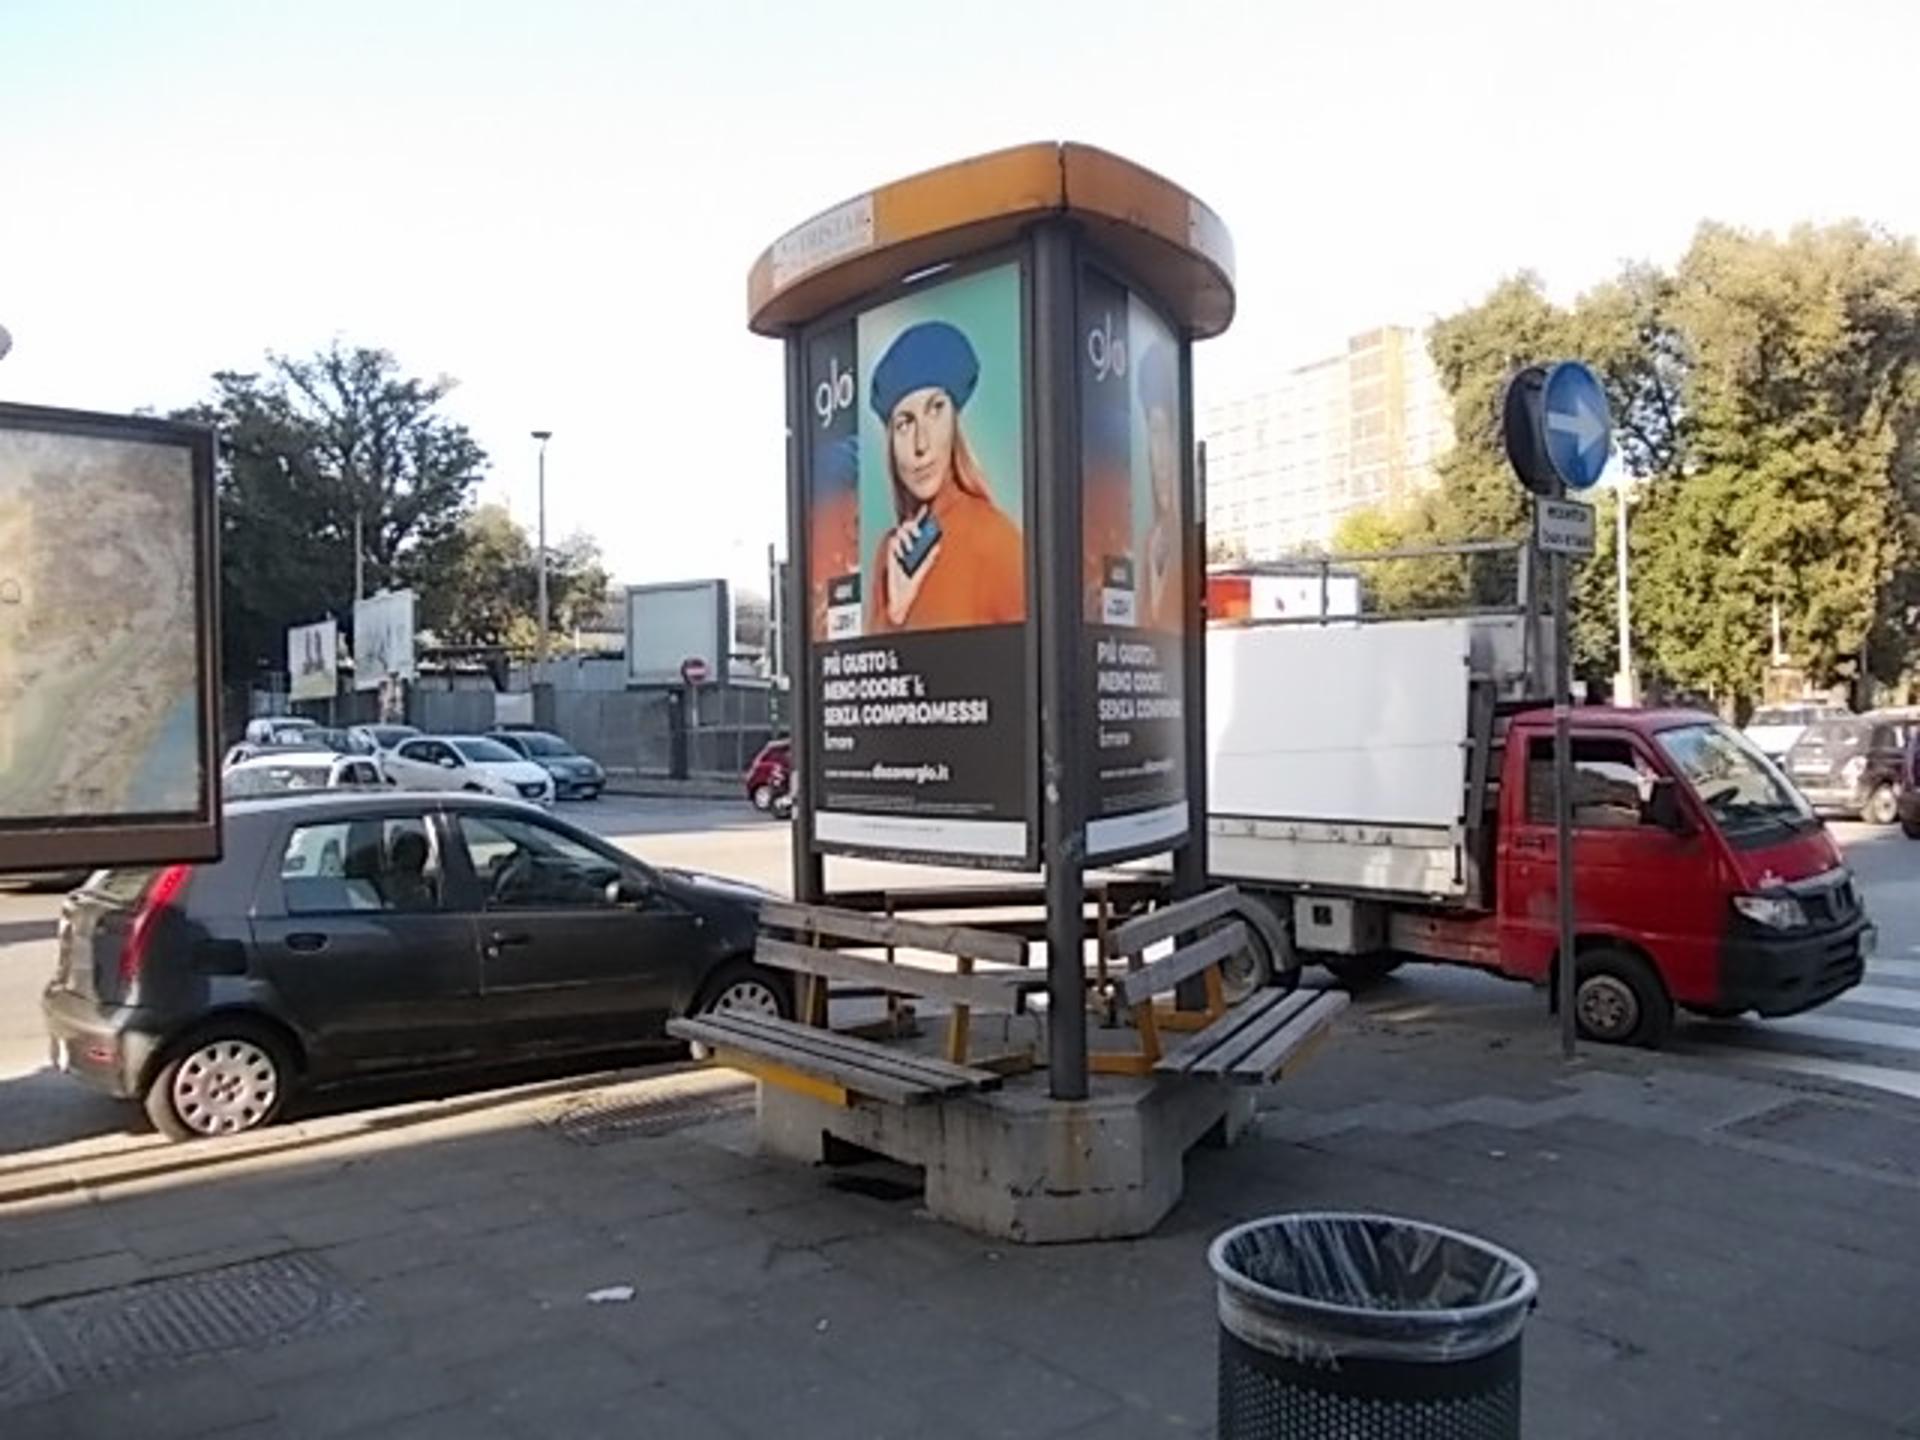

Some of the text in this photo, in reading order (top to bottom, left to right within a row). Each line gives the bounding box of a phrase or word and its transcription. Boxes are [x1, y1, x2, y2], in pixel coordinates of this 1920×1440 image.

[1088, 311, 1126, 381] glo
[816, 357, 854, 428] glo
[842, 651, 886, 674] GUSTO
[862, 699, 988, 725] COMPROMESSI
